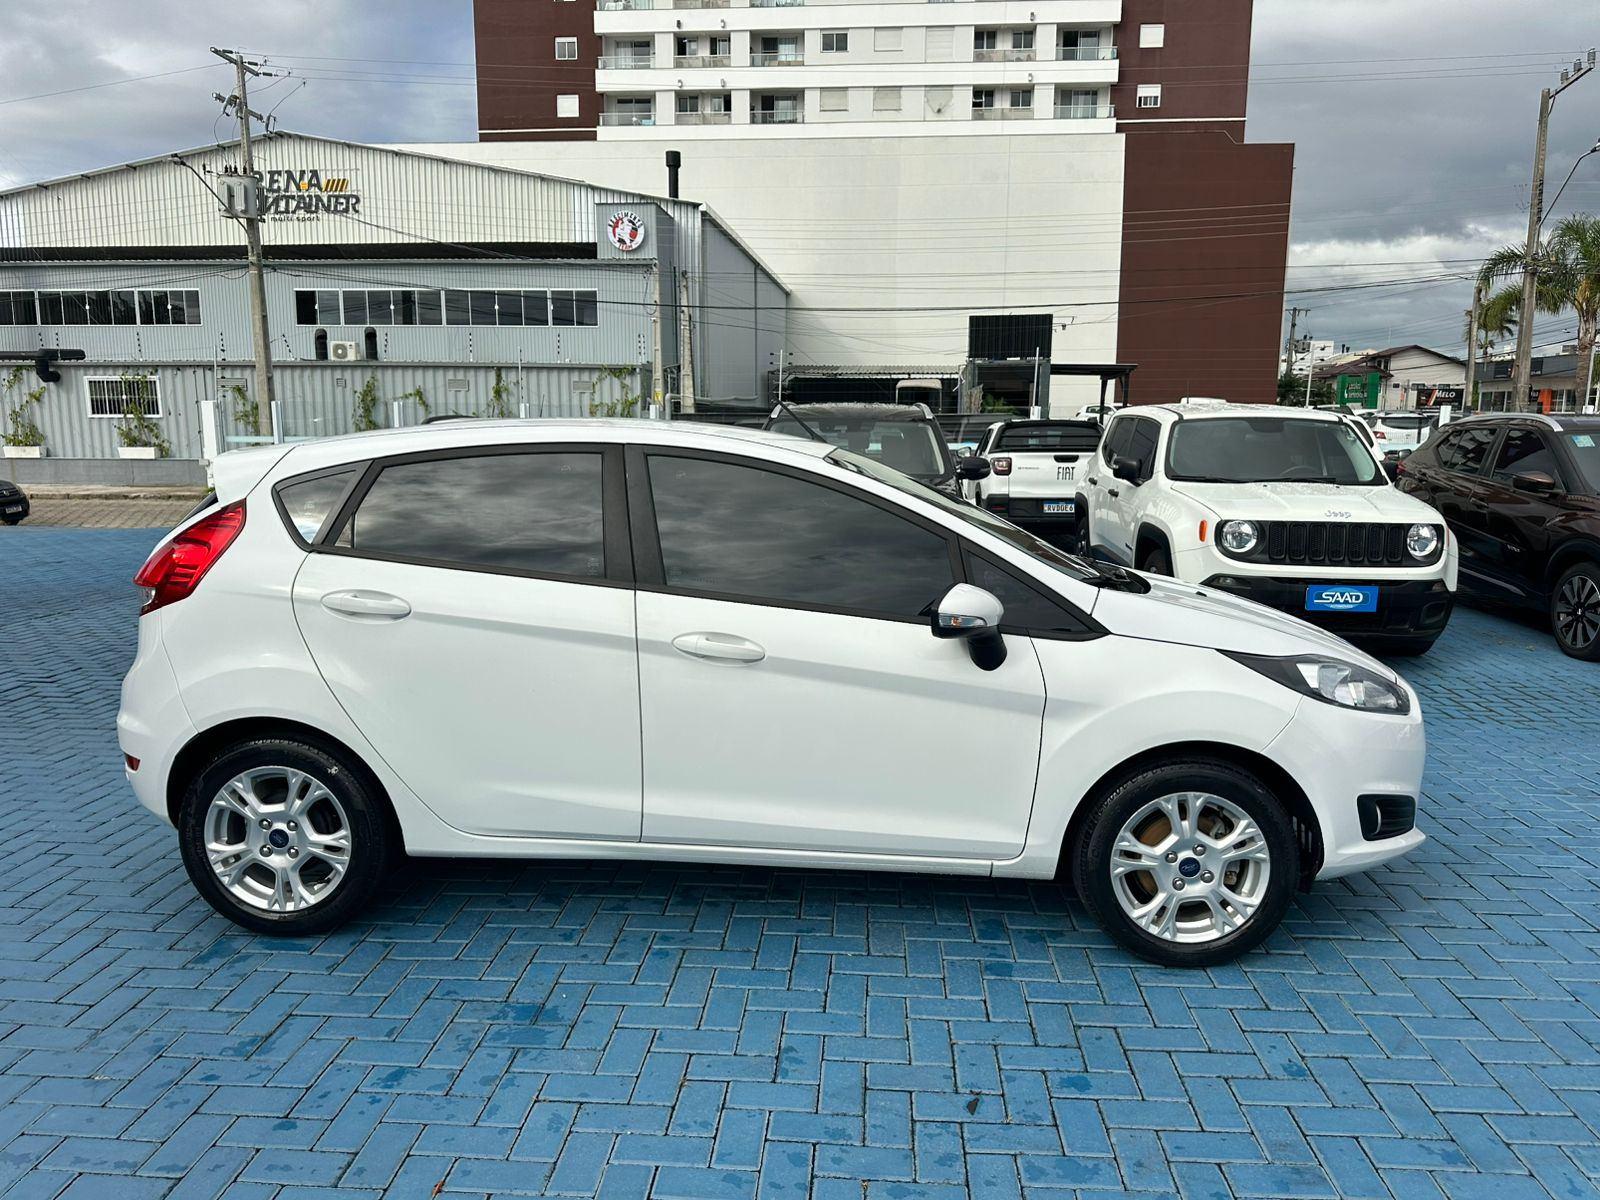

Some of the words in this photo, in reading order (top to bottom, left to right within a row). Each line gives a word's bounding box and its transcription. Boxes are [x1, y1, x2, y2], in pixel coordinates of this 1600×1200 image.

[253, 170, 323, 193] RENA
[264, 194, 360, 214] NTAINER
[296, 215, 320, 223] sport
[1436, 390, 1456, 398] MELO
[1057, 466, 1075, 480] FIAT
[1314, 592, 1363, 603] SAAD
